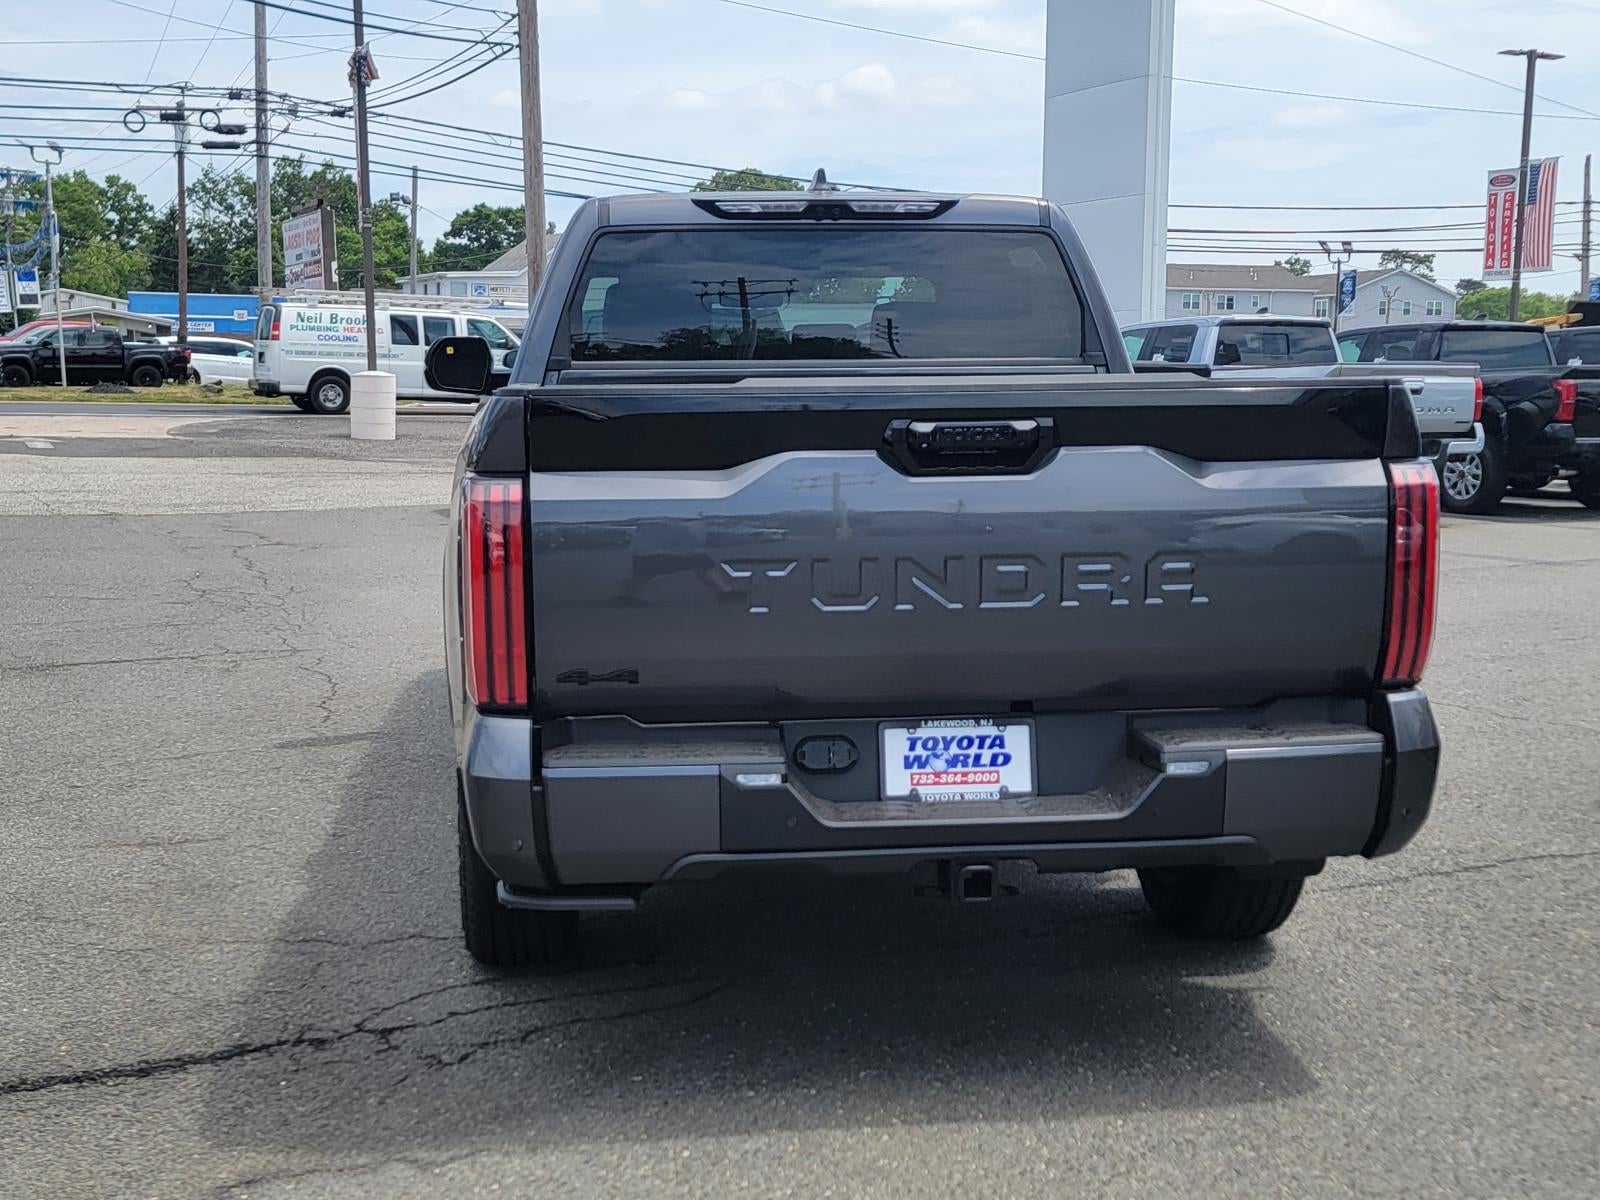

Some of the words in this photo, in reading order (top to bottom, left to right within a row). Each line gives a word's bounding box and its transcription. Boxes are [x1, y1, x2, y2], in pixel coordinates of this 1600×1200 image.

[1486, 195, 1497, 267] TOYOTA
[1501, 193, 1513, 267] CERTIFIED
[296, 311, 323, 324] Neil
[289, 324, 339, 333] PLUMBING
[343, 326, 384, 335] HEATG
[317, 334, 359, 342] COOLING
[1415, 406, 1456, 415] OMA
[721, 550, 1210, 613] TUNDRA
[921, 719, 977, 728] LAKEWOOD,
[981, 718, 993, 727] NJ
[906, 734, 1006, 752] TOYOTA
[903, 751, 1012, 771] WORLD
[912, 772, 998, 785] 732-364-9000
[920, 792, 962, 802] TOYOTA
[963, 791, 1000, 801] WORLD
